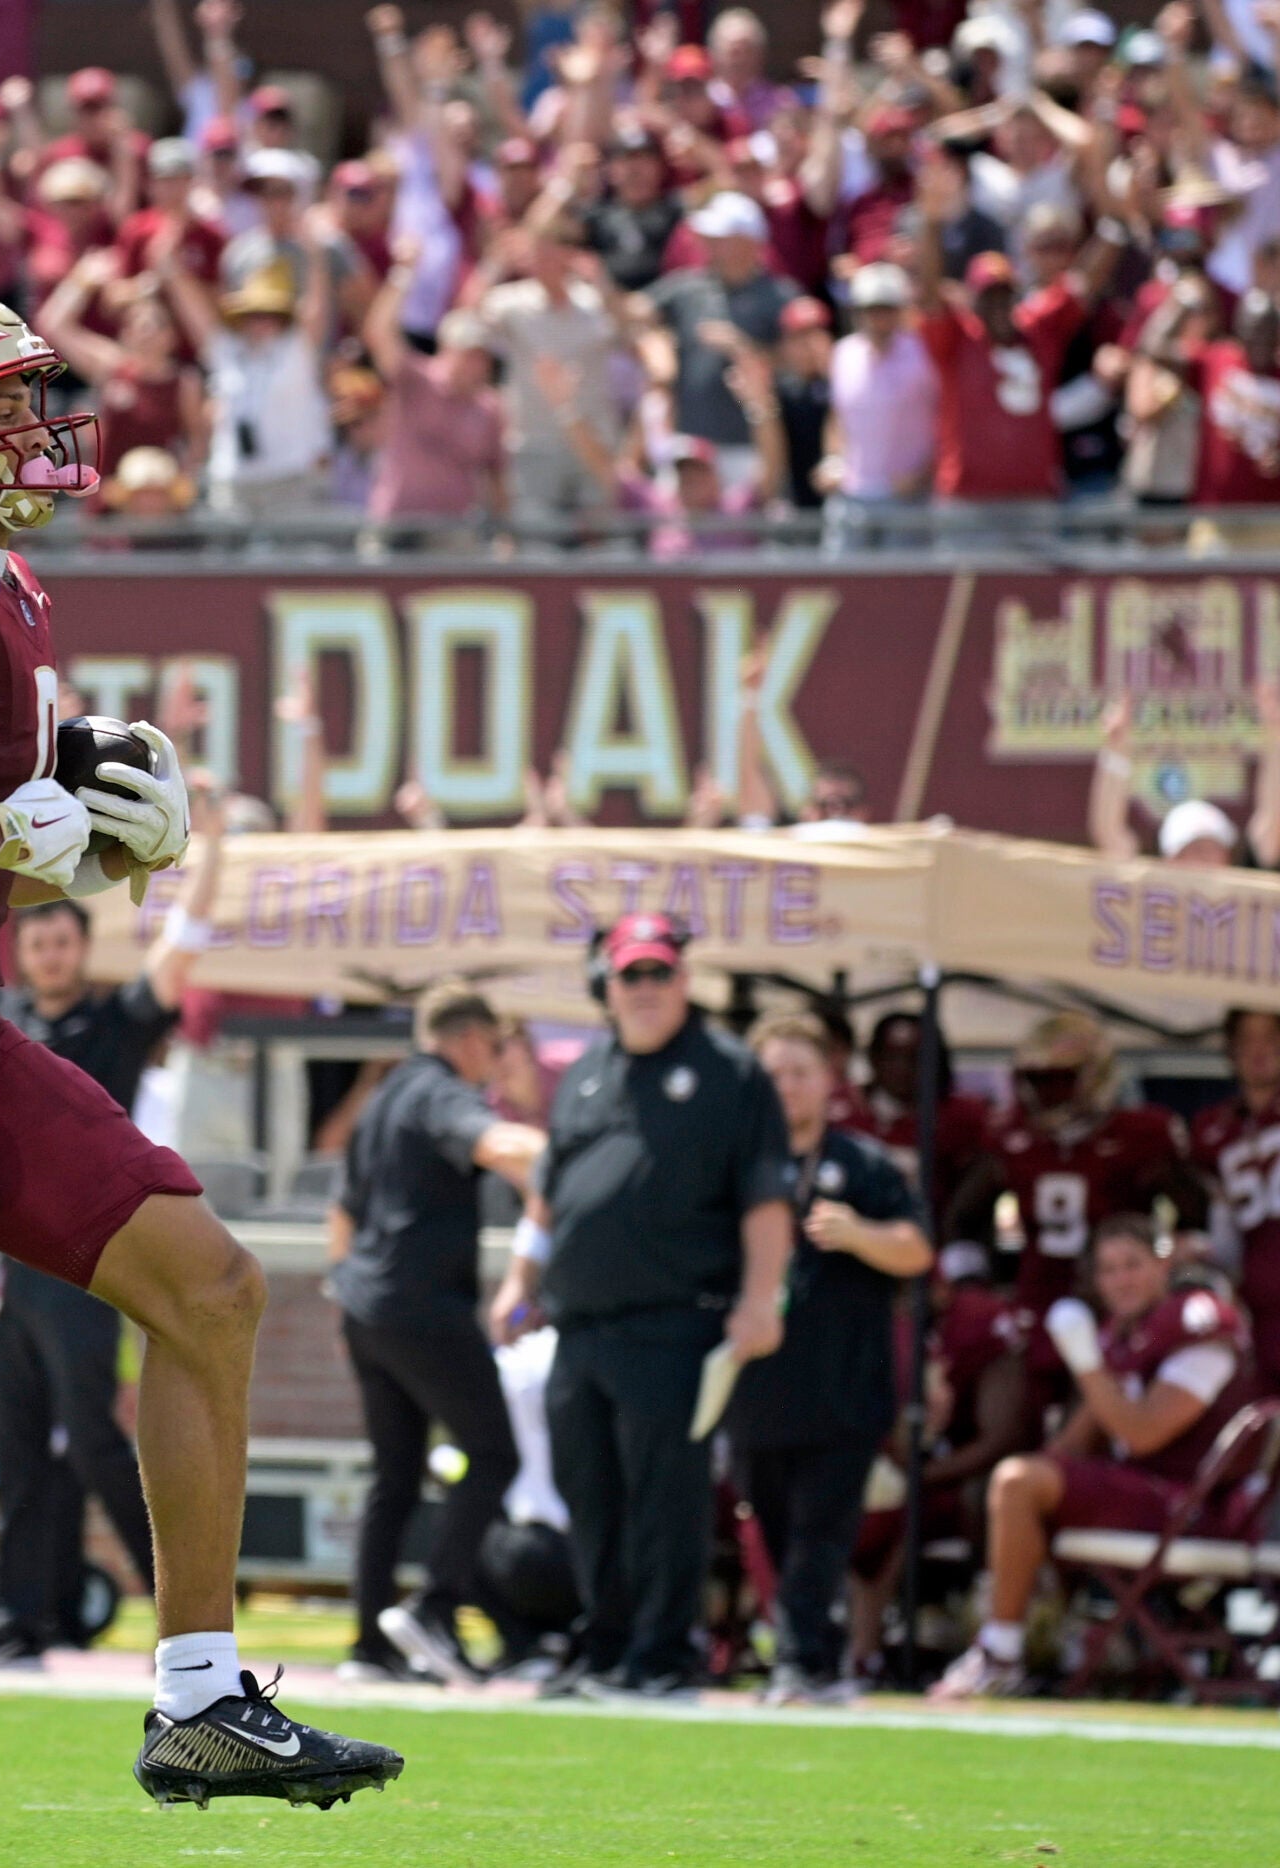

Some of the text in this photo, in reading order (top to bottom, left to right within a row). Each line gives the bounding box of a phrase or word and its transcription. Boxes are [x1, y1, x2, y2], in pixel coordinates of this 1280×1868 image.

[269, 584, 839, 819] DOAK
[550, 860, 817, 944] STATE
[1090, 882, 1280, 980] SEMI
[1034, 1172, 1088, 1257] 9
